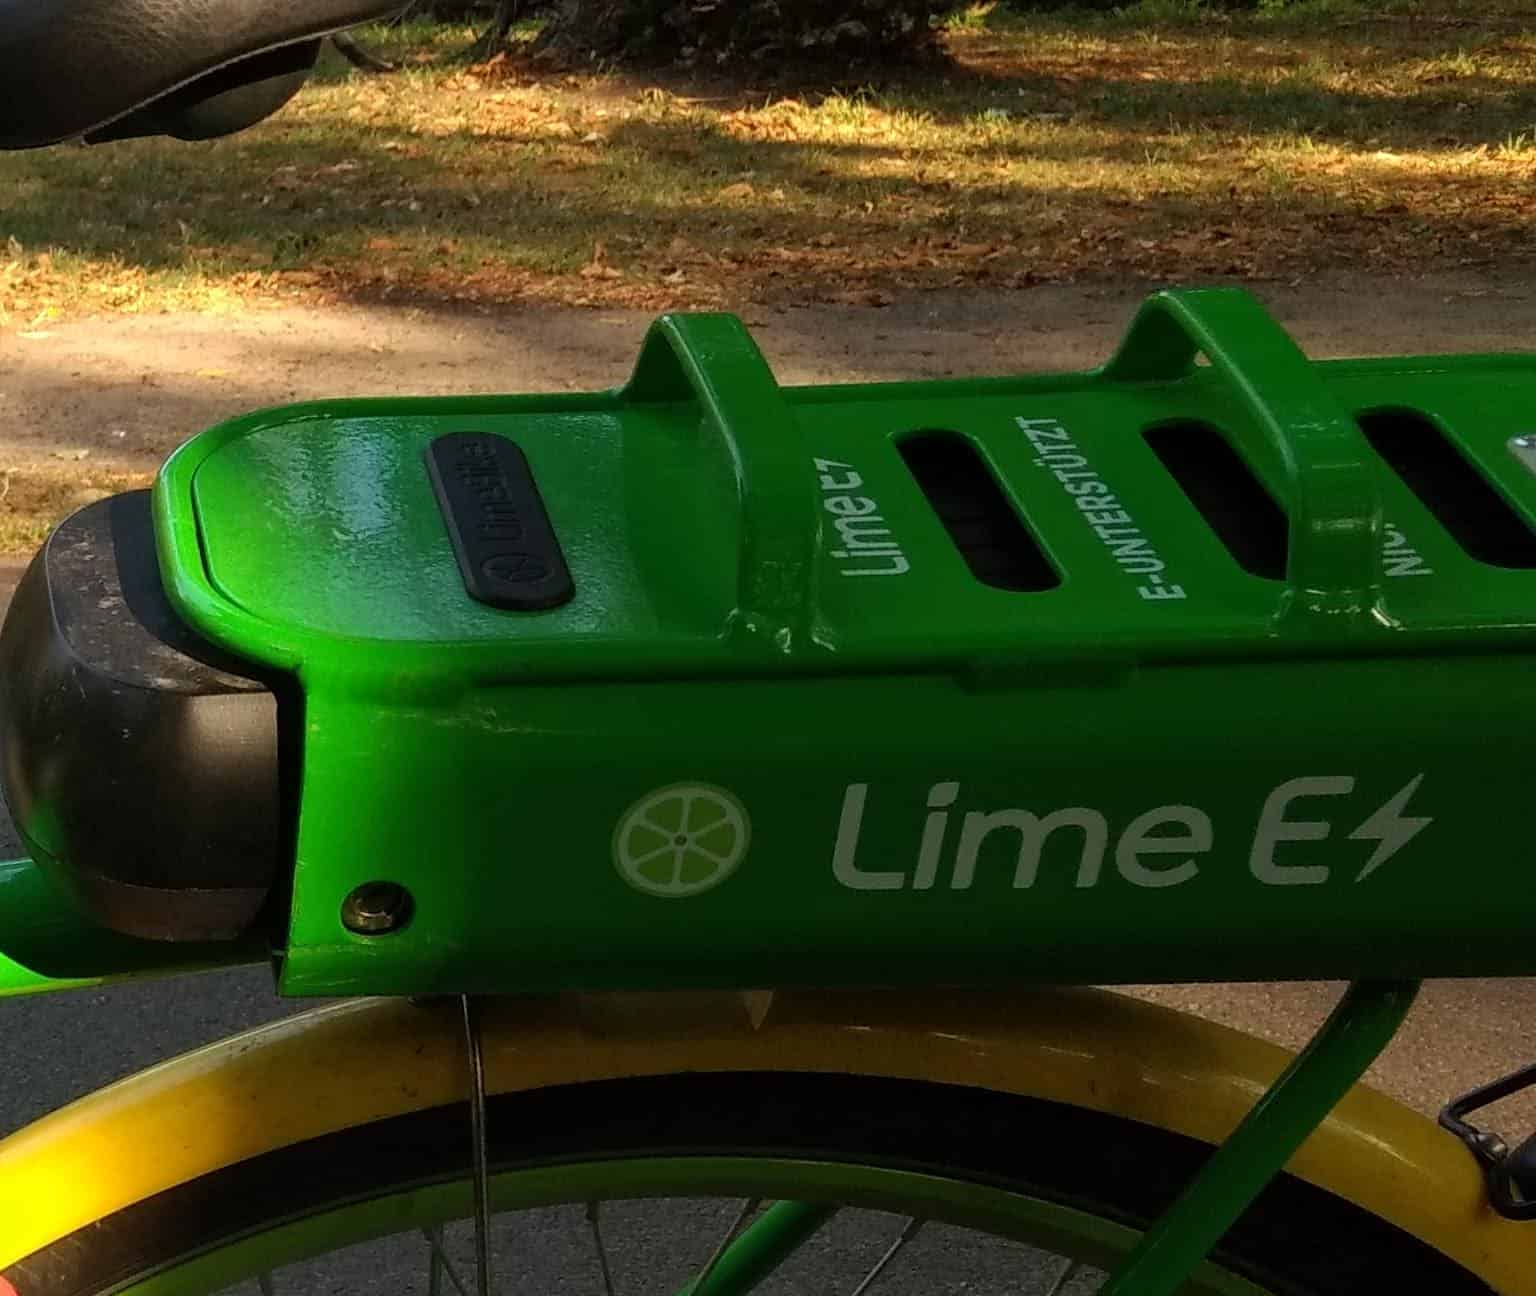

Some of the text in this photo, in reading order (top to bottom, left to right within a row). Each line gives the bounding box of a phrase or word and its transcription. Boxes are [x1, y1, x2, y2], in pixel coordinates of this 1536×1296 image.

[823, 496, 912, 577] Lime
[1015, 415, 1187, 600] E-UNTERSTÜTZT
[831, 781, 1214, 890] Lime
